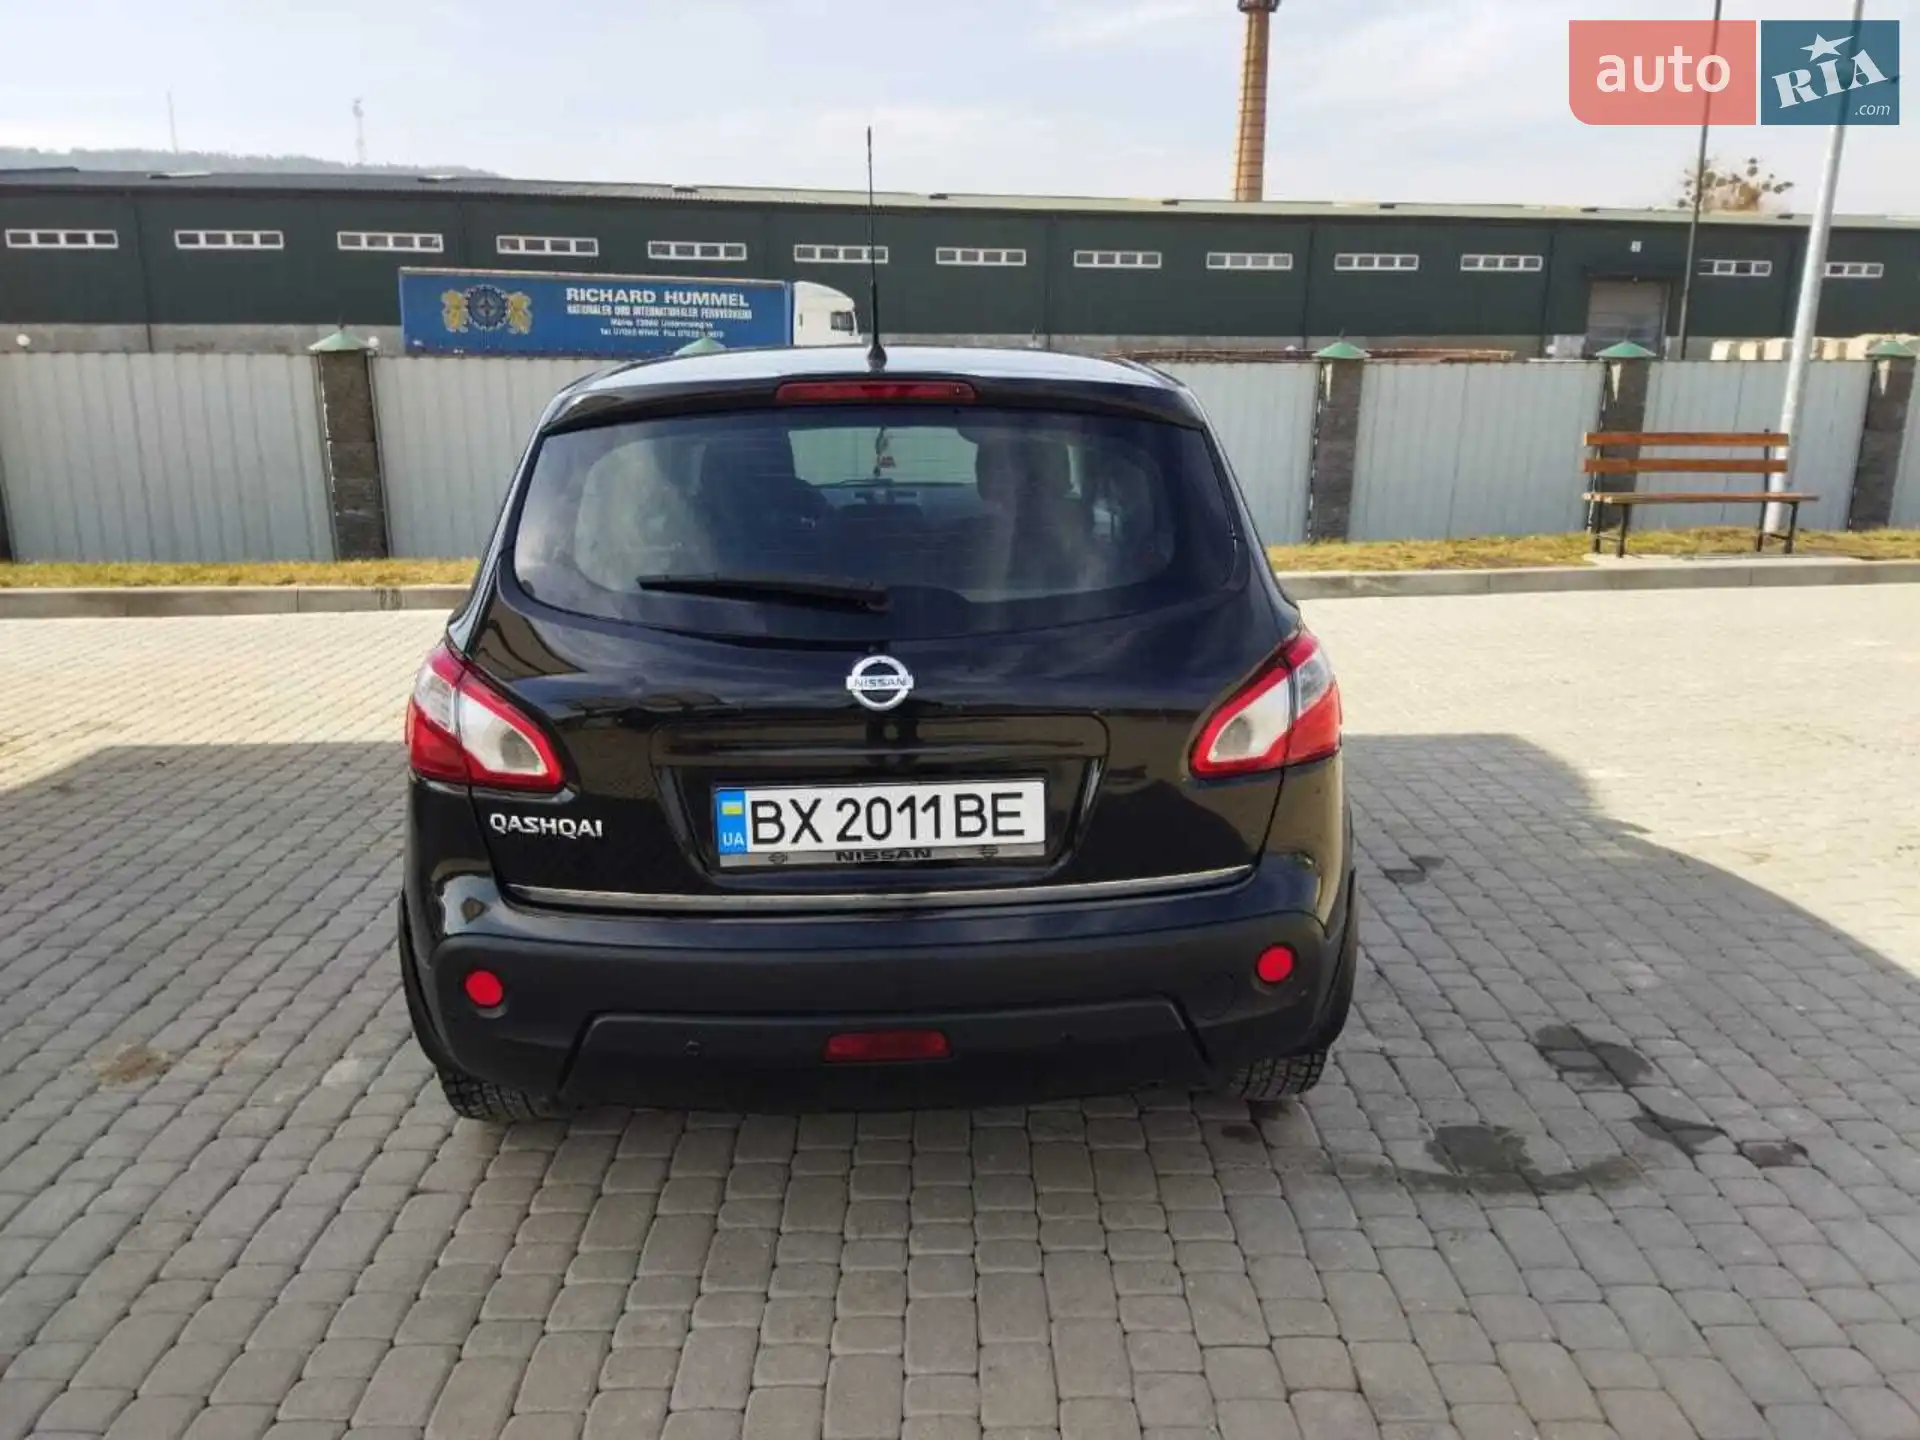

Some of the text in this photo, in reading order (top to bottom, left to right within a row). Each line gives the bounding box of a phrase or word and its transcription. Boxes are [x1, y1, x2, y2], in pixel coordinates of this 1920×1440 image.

[566, 287, 749, 307] RICHARD HUMMEL
[854, 676, 906, 688] NISSAN
[489, 813, 603, 839] QASHQAI
[751, 792, 1025, 845] BX 2011 BE
[722, 833, 744, 847] UA
[835, 848, 932, 862] NISSAN
